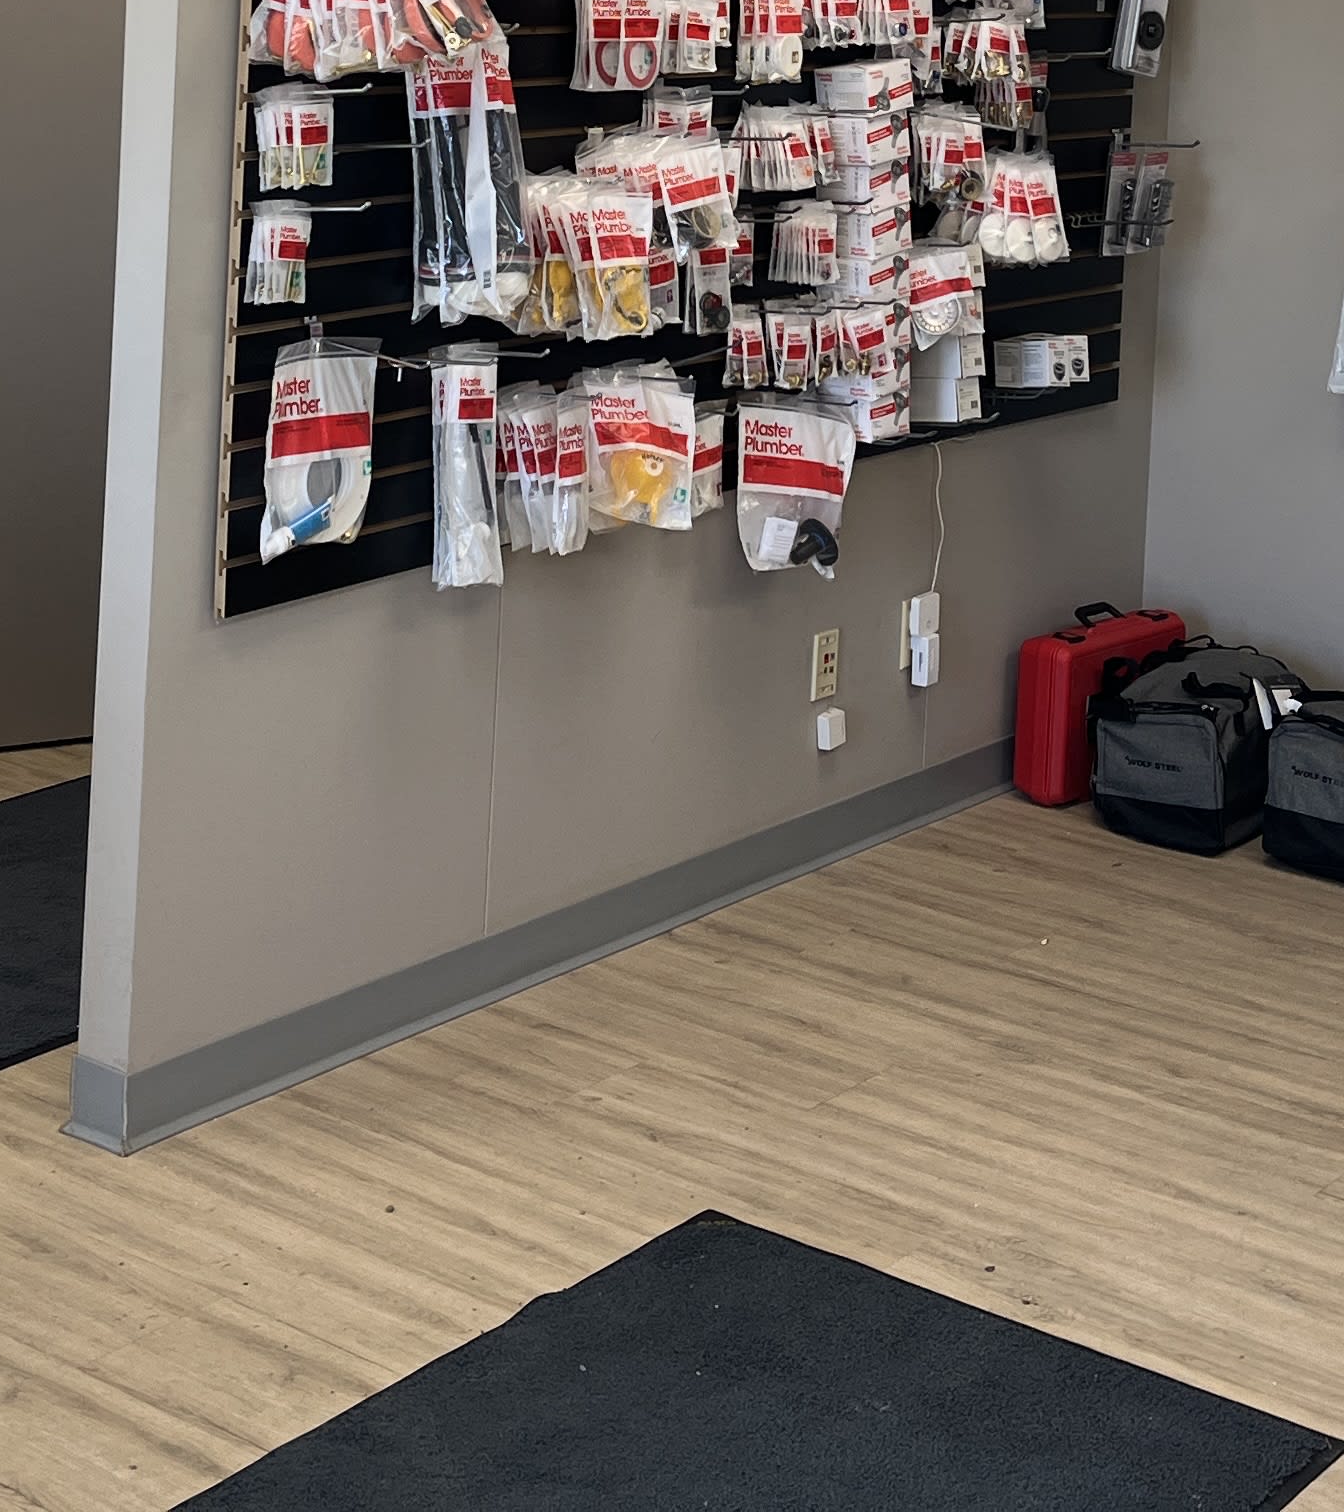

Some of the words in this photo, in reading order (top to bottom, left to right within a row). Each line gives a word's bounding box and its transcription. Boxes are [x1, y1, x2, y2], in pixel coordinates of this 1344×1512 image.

[427, 55, 465, 70] Maer
[429, 68, 473, 83] Plumber
[910, 275, 936, 287] umber
[590, 394, 636, 409] Master
[591, 407, 649, 421] Plumber
[745, 419, 793, 439] Master
[745, 437, 803, 456] Plumber
[1127, 756, 1153, 768] WOLF
[1293, 768, 1320, 781] WOLF
